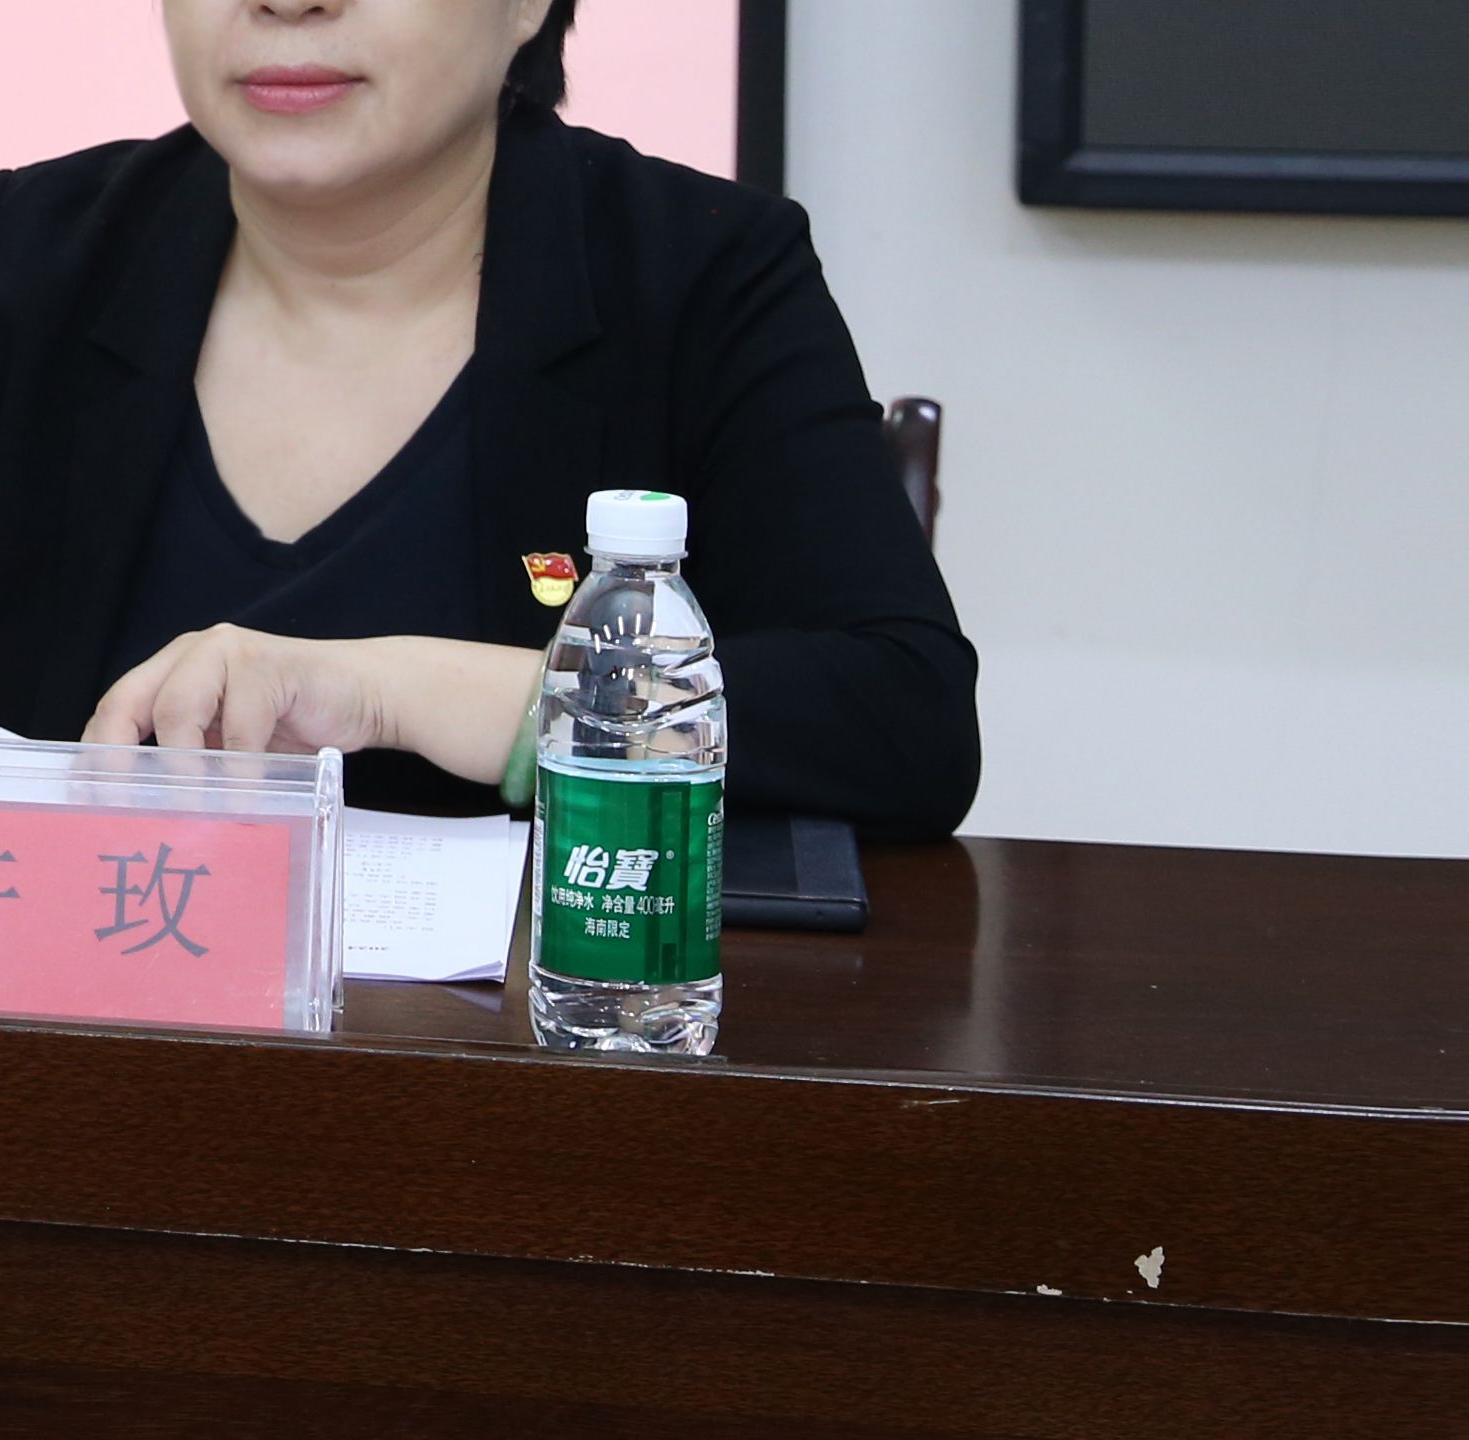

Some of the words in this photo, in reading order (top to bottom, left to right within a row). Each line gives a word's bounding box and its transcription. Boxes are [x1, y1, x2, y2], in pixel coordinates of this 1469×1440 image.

[564, 845, 659, 891] 怡寶
[585, 917, 630, 939] 海南限定
